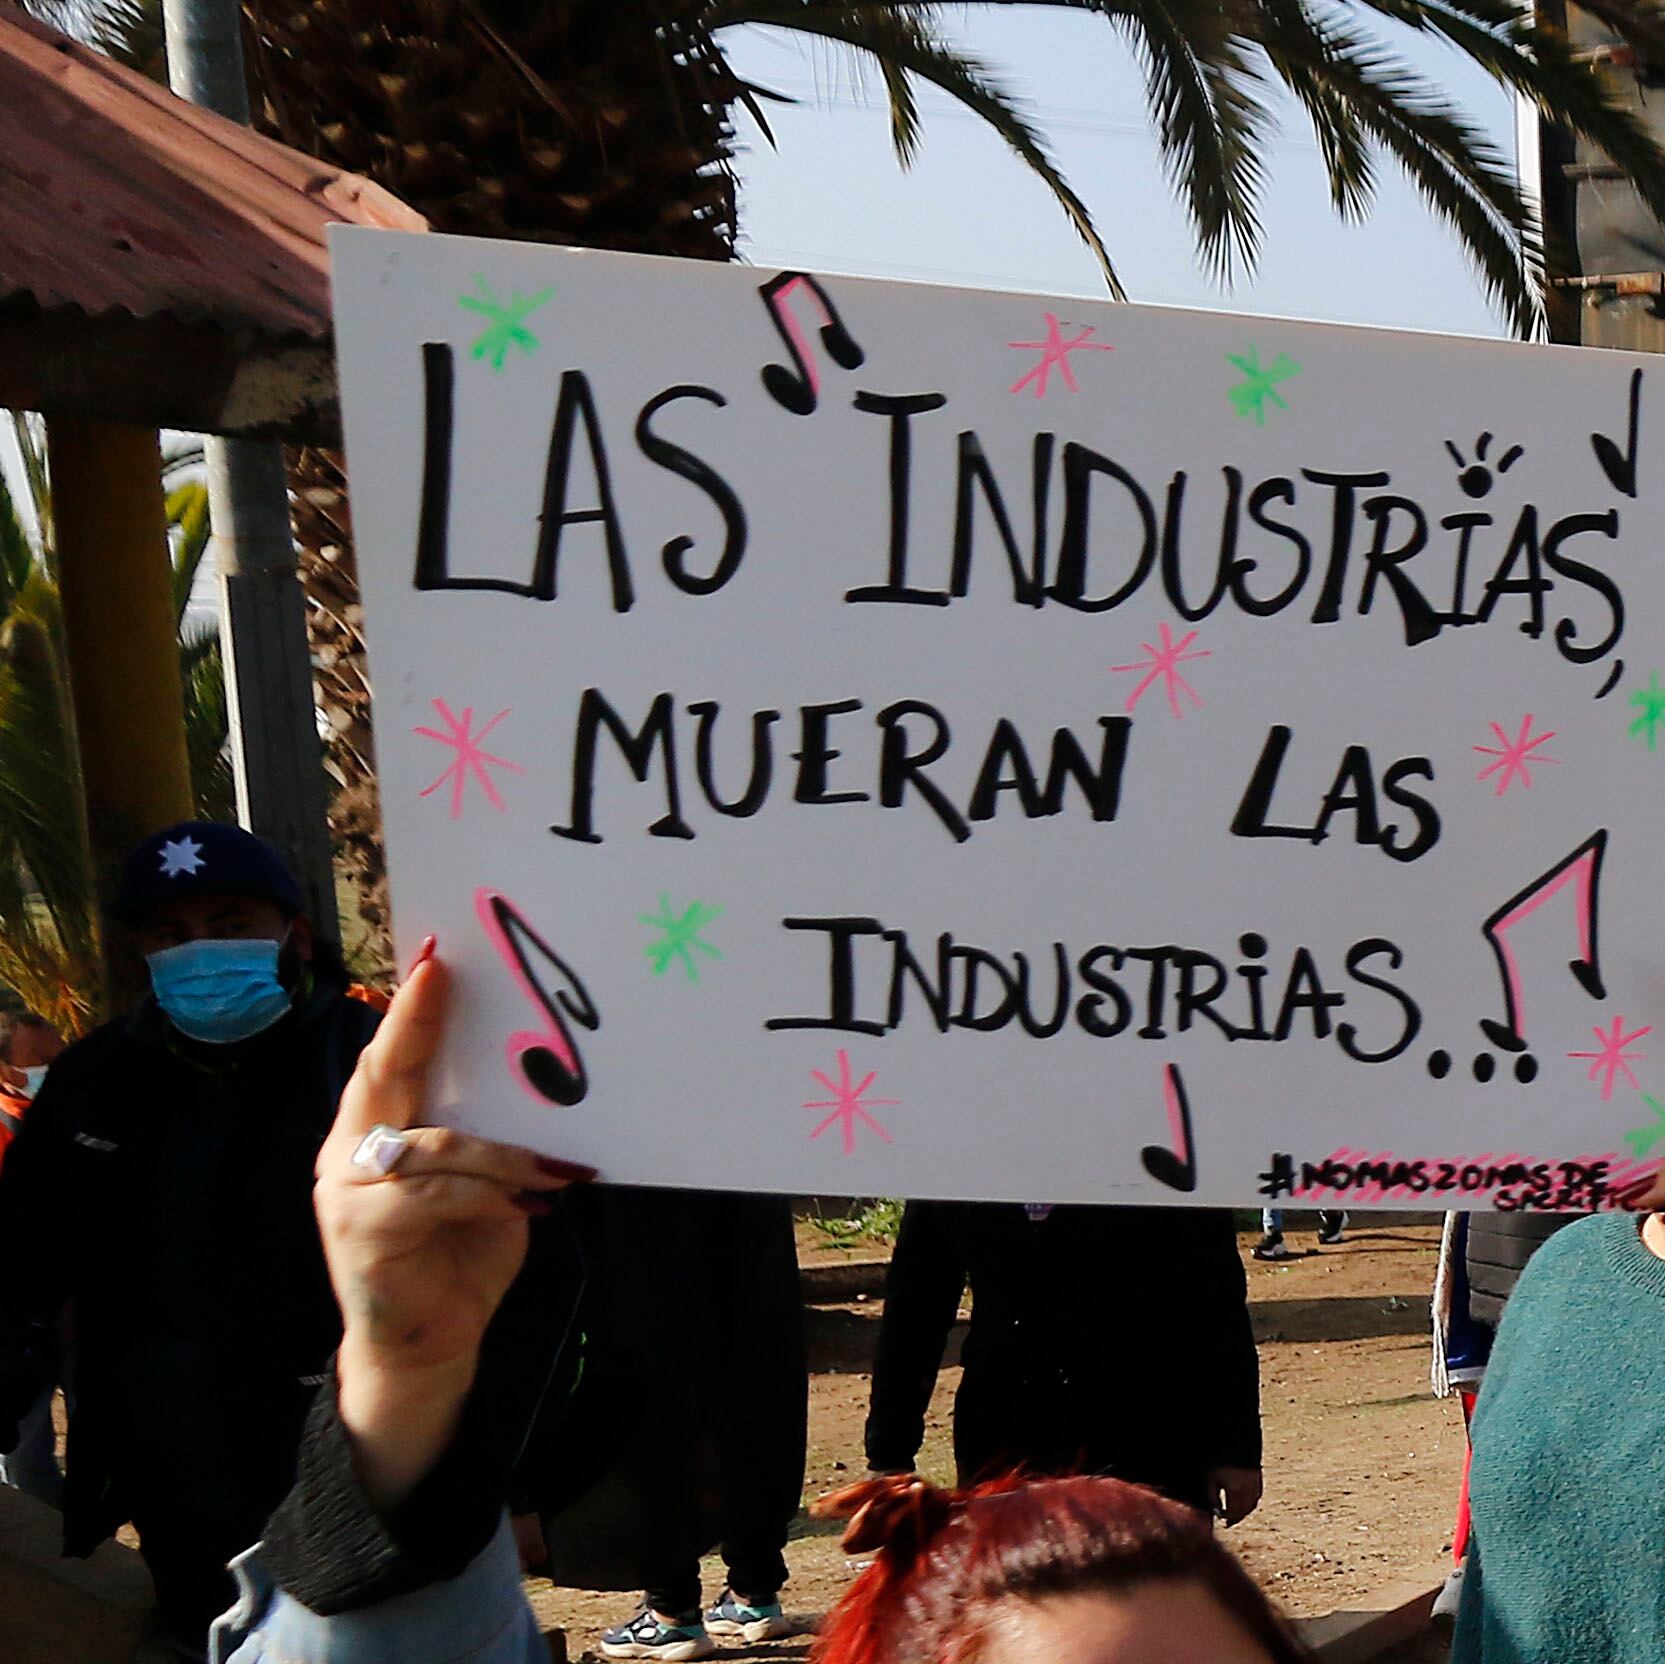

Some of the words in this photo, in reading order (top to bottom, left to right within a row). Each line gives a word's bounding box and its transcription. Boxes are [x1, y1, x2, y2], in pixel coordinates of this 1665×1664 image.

[413, 342, 749, 613] LAS
[550, 688, 1132, 845] MUERAN
[1230, 725, 1442, 862] LAS
